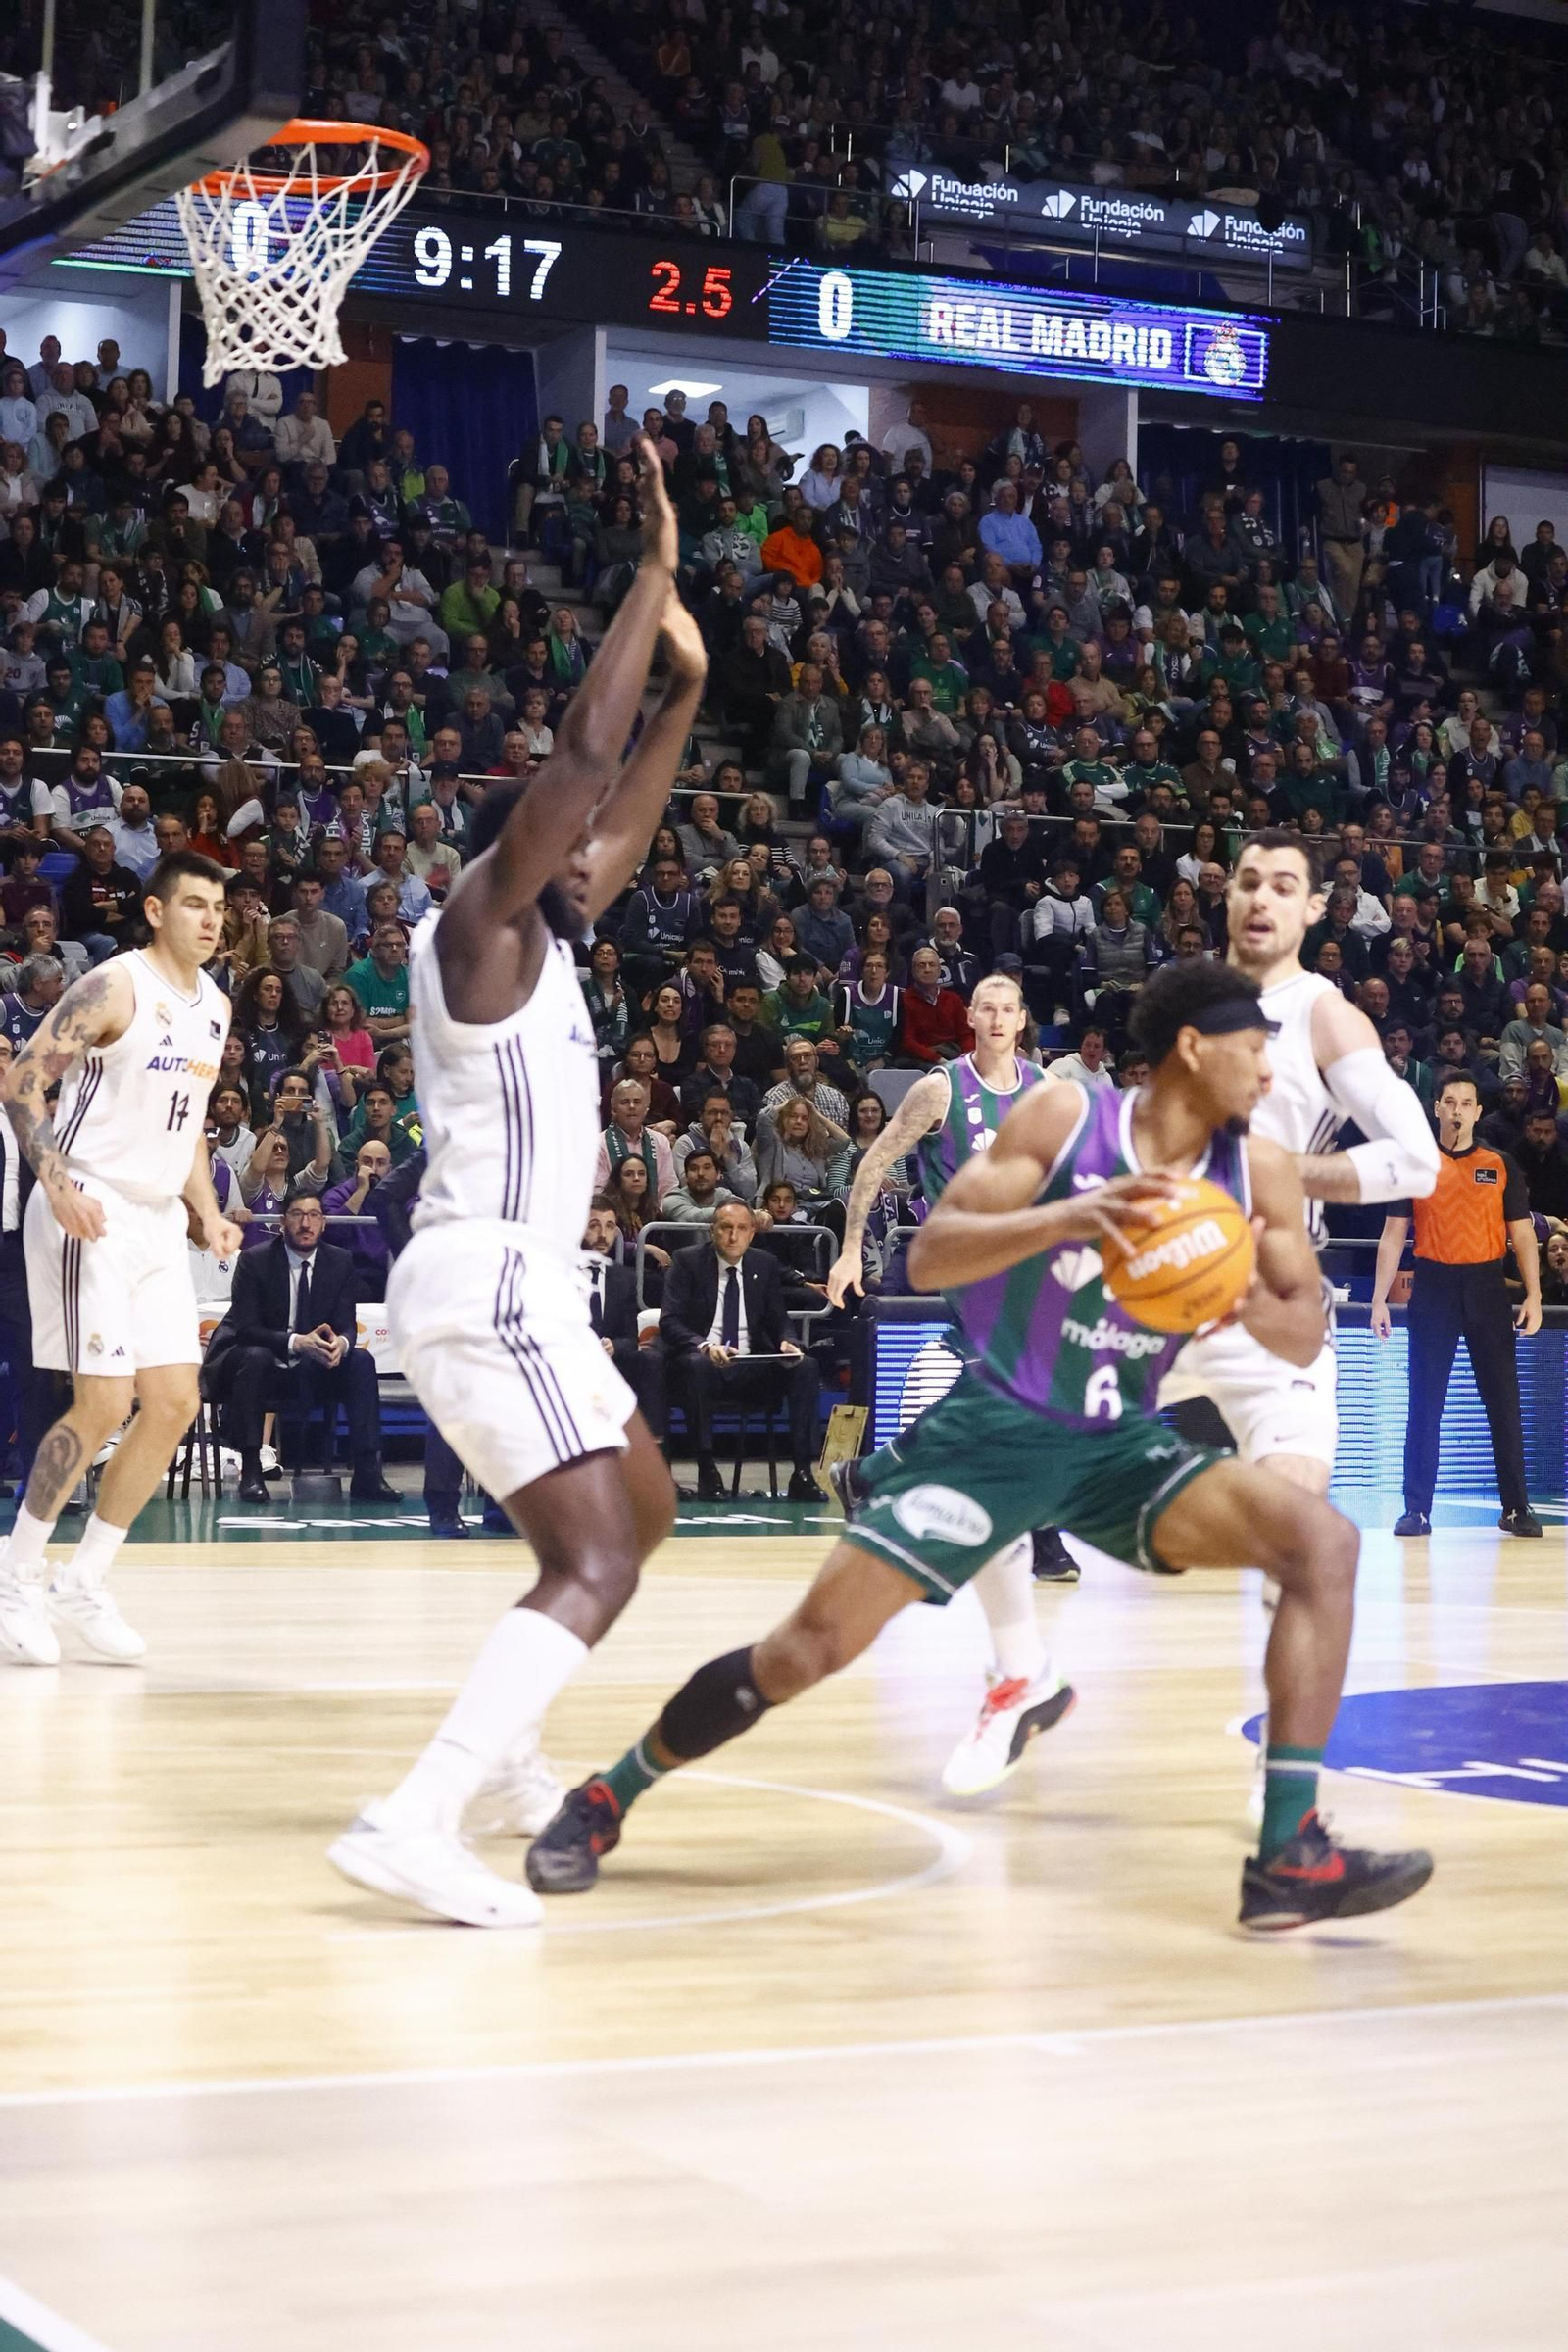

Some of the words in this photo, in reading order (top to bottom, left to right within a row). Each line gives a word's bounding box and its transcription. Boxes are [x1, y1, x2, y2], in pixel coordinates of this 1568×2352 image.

[1081, 195, 1164, 221] Fundación
[414, 226, 562, 299] 9:17
[650, 261, 732, 318] 2.5
[818, 271, 854, 340] 0
[928, 301, 1020, 351] REAL
[1031, 313, 1172, 369] MADRID
[167, 1090, 189, 1131] 14
[1084, 1364, 1124, 1420] 6
